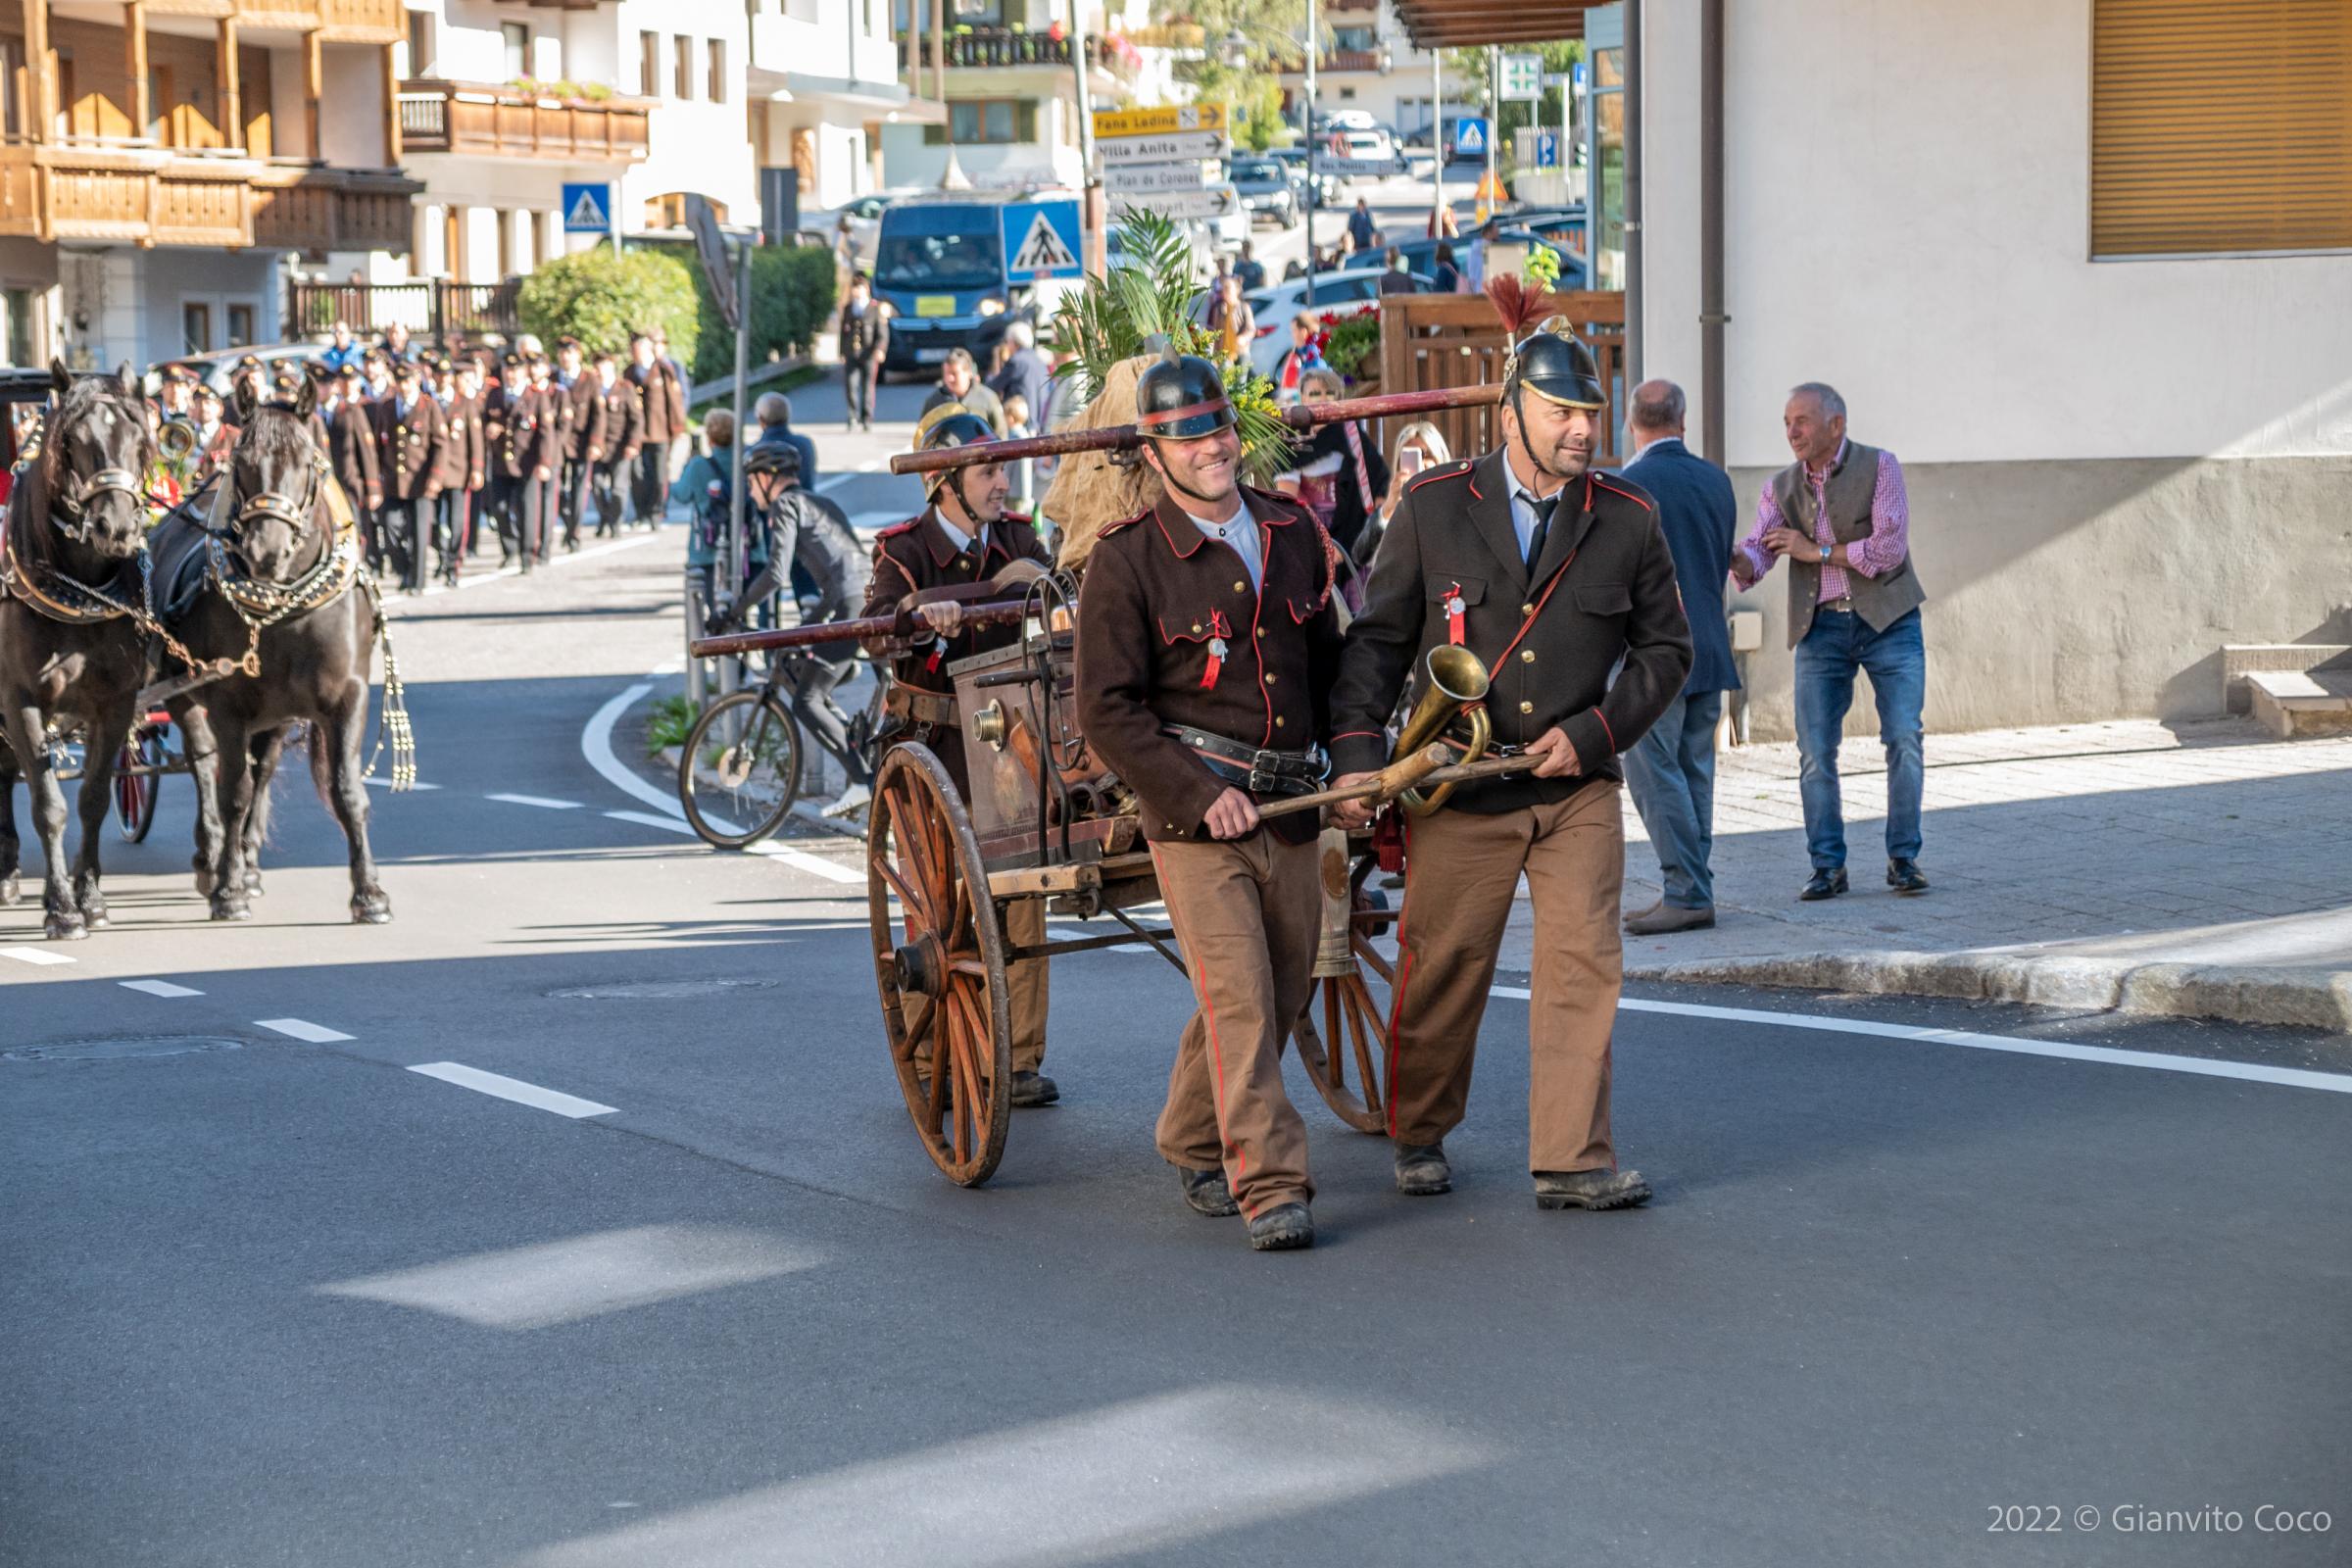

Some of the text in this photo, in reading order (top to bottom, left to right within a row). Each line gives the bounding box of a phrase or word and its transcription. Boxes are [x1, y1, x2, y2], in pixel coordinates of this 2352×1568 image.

[1134, 114, 1177, 128] Ladina
[1099, 143, 1131, 157] Villa
[1139, 141, 1177, 155] Anita
[1143, 173, 1154, 185] de
